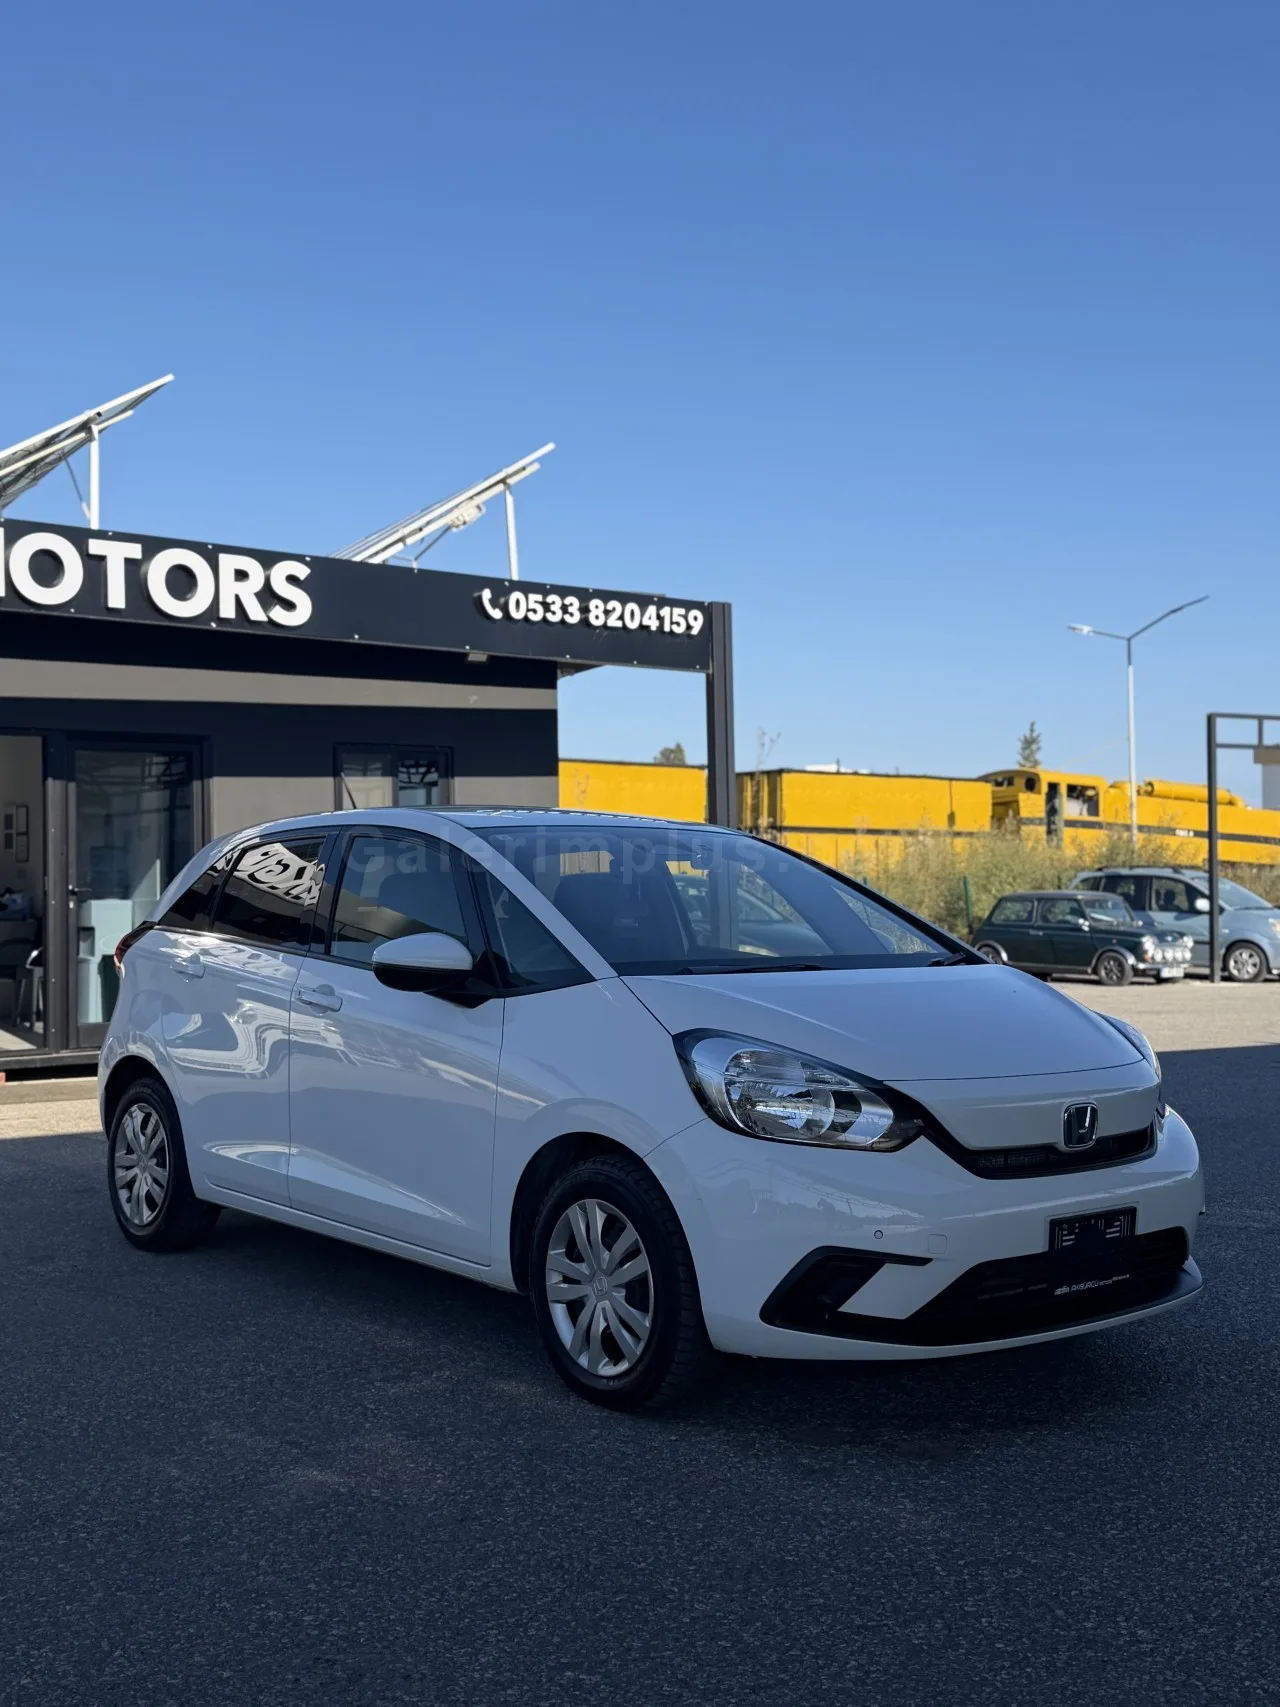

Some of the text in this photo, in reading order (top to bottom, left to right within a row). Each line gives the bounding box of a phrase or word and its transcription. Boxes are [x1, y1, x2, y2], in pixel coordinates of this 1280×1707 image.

[0, 527, 313, 627] OTORS
[508, 591, 704, 636] 0533 8204159
